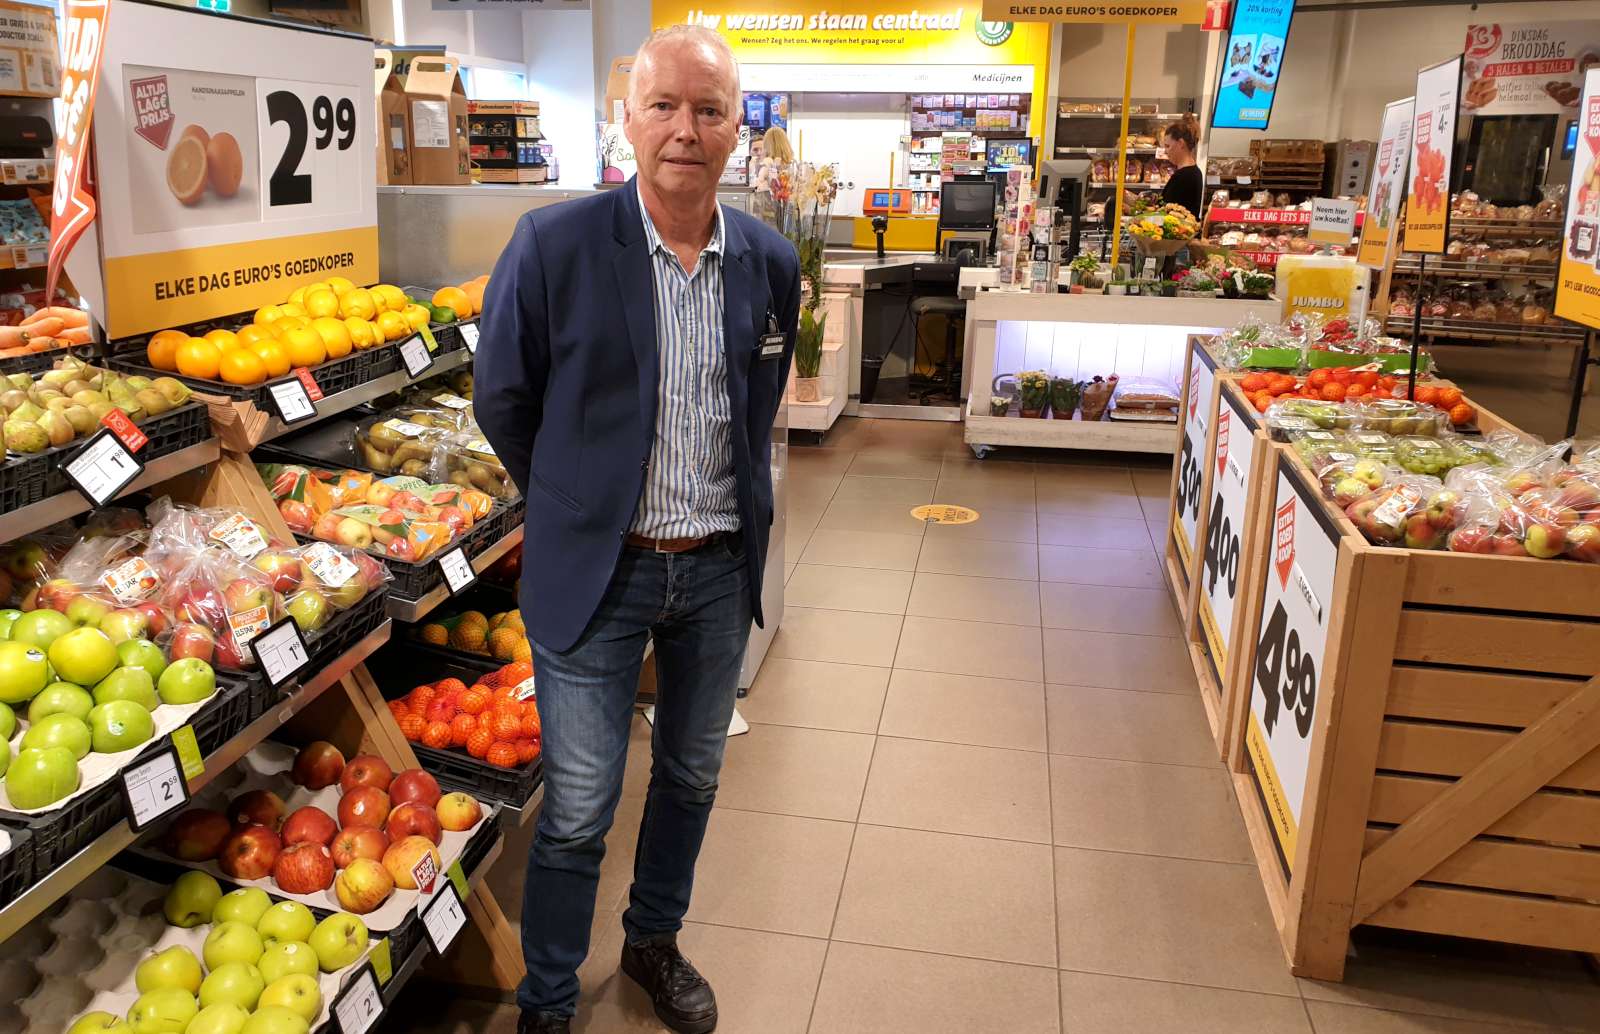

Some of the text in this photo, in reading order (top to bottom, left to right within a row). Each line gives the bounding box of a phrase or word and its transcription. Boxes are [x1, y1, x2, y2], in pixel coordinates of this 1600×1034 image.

[1010, 5, 1178, 16] ELKE DAG EURO'S GOEDKOPER
[725, 13, 804, 31] wensen
[808, 11, 868, 31] staan
[872, 8, 963, 31] centraal
[1511, 29, 1549, 41] DINSDAG
[771, 38, 782, 46] Zeg
[822, 38, 847, 46] regelen
[861, 38, 880, 46] graag
[1502, 41, 1566, 60] BROODDAG
[1536, 60, 1571, 74] BETALEN
[972, 74, 1023, 84] Medicijnen
[136, 82, 166, 99] ALTIJD
[137, 95, 168, 114] LAGE
[140, 108, 170, 129] PRIJS
[1243, 211, 1261, 221] ELKE
[1264, 211, 1278, 222] DAG
[1280, 211, 1297, 222] IETS
[1316, 205, 1348, 215] Neem hier
[1257, 253, 1272, 263] DAG
[155, 252, 354, 301] ELKE DAG EURO'S GOEDKOPER
[1291, 296, 1345, 309] JUMBO
[234, 624, 255, 638] ELSTAR
